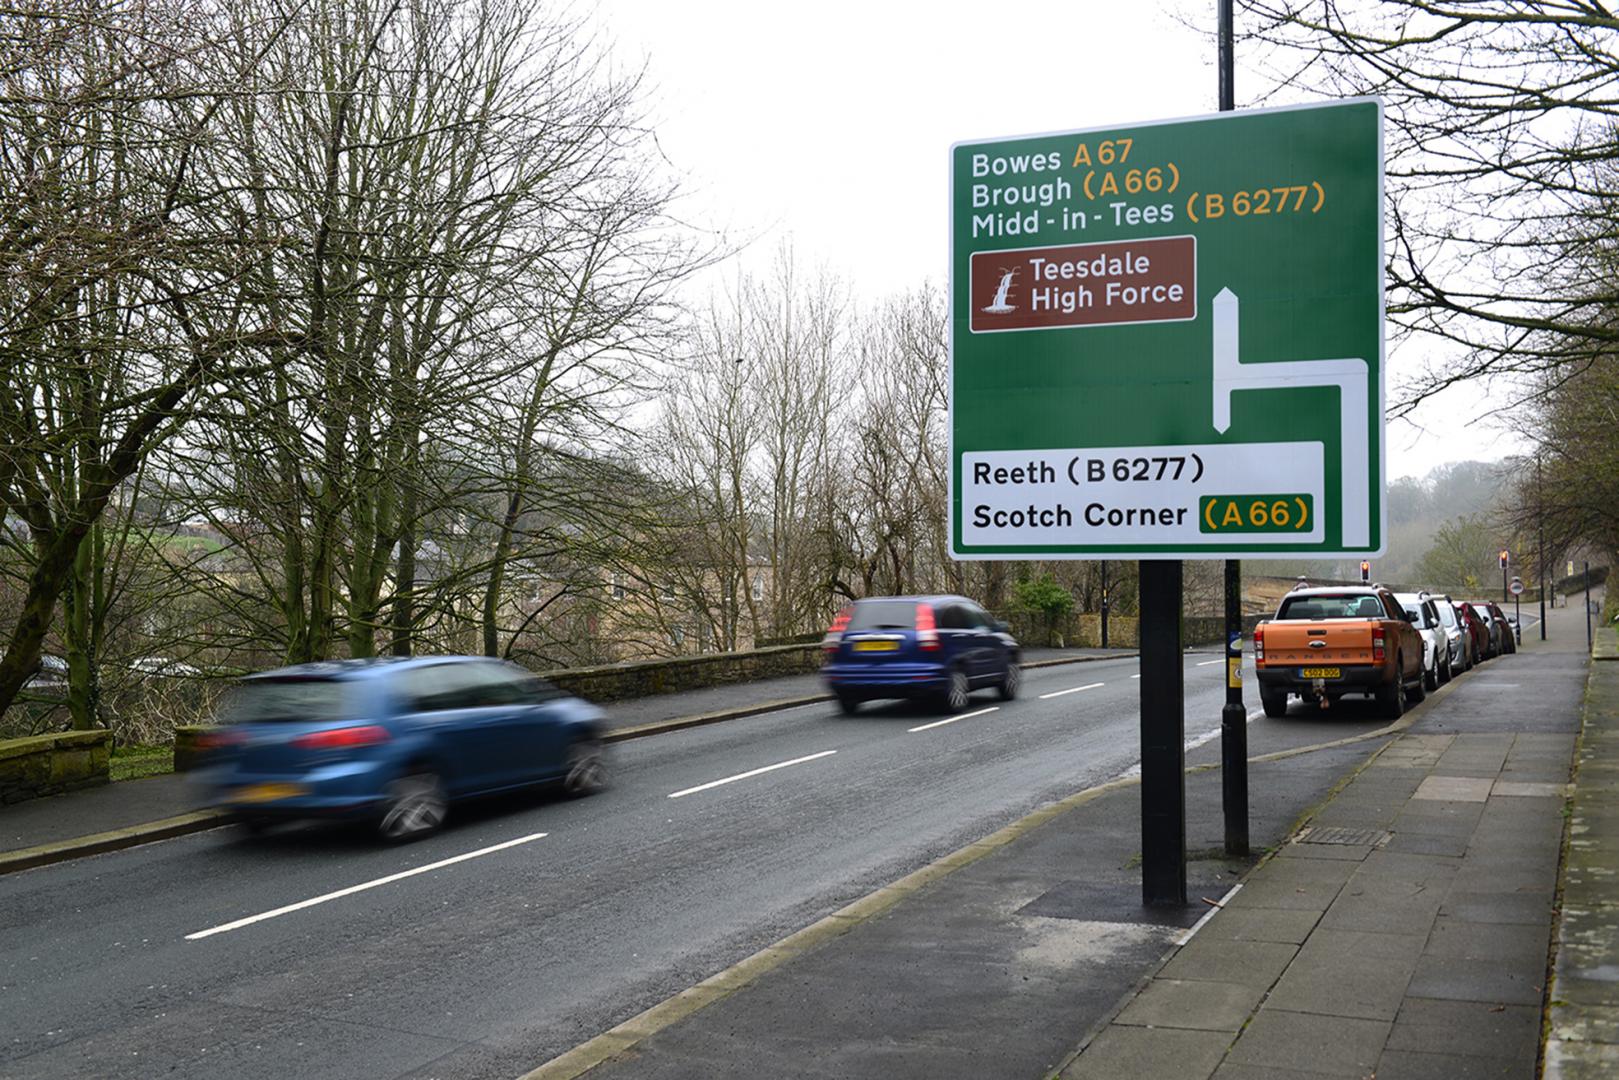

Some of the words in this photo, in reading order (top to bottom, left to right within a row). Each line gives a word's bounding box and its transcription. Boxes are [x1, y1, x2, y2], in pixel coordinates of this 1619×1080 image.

[972, 152, 1062, 178] Bowes
[972, 176, 1072, 208] Brough
[1029, 251, 1151, 282] Teesdale
[1031, 284, 1094, 315] High
[1105, 282, 1185, 307] Force
[973, 460, 1057, 486] Reeth
[972, 503, 1073, 529] Scotch
[1083, 502, 1189, 528] Corner
